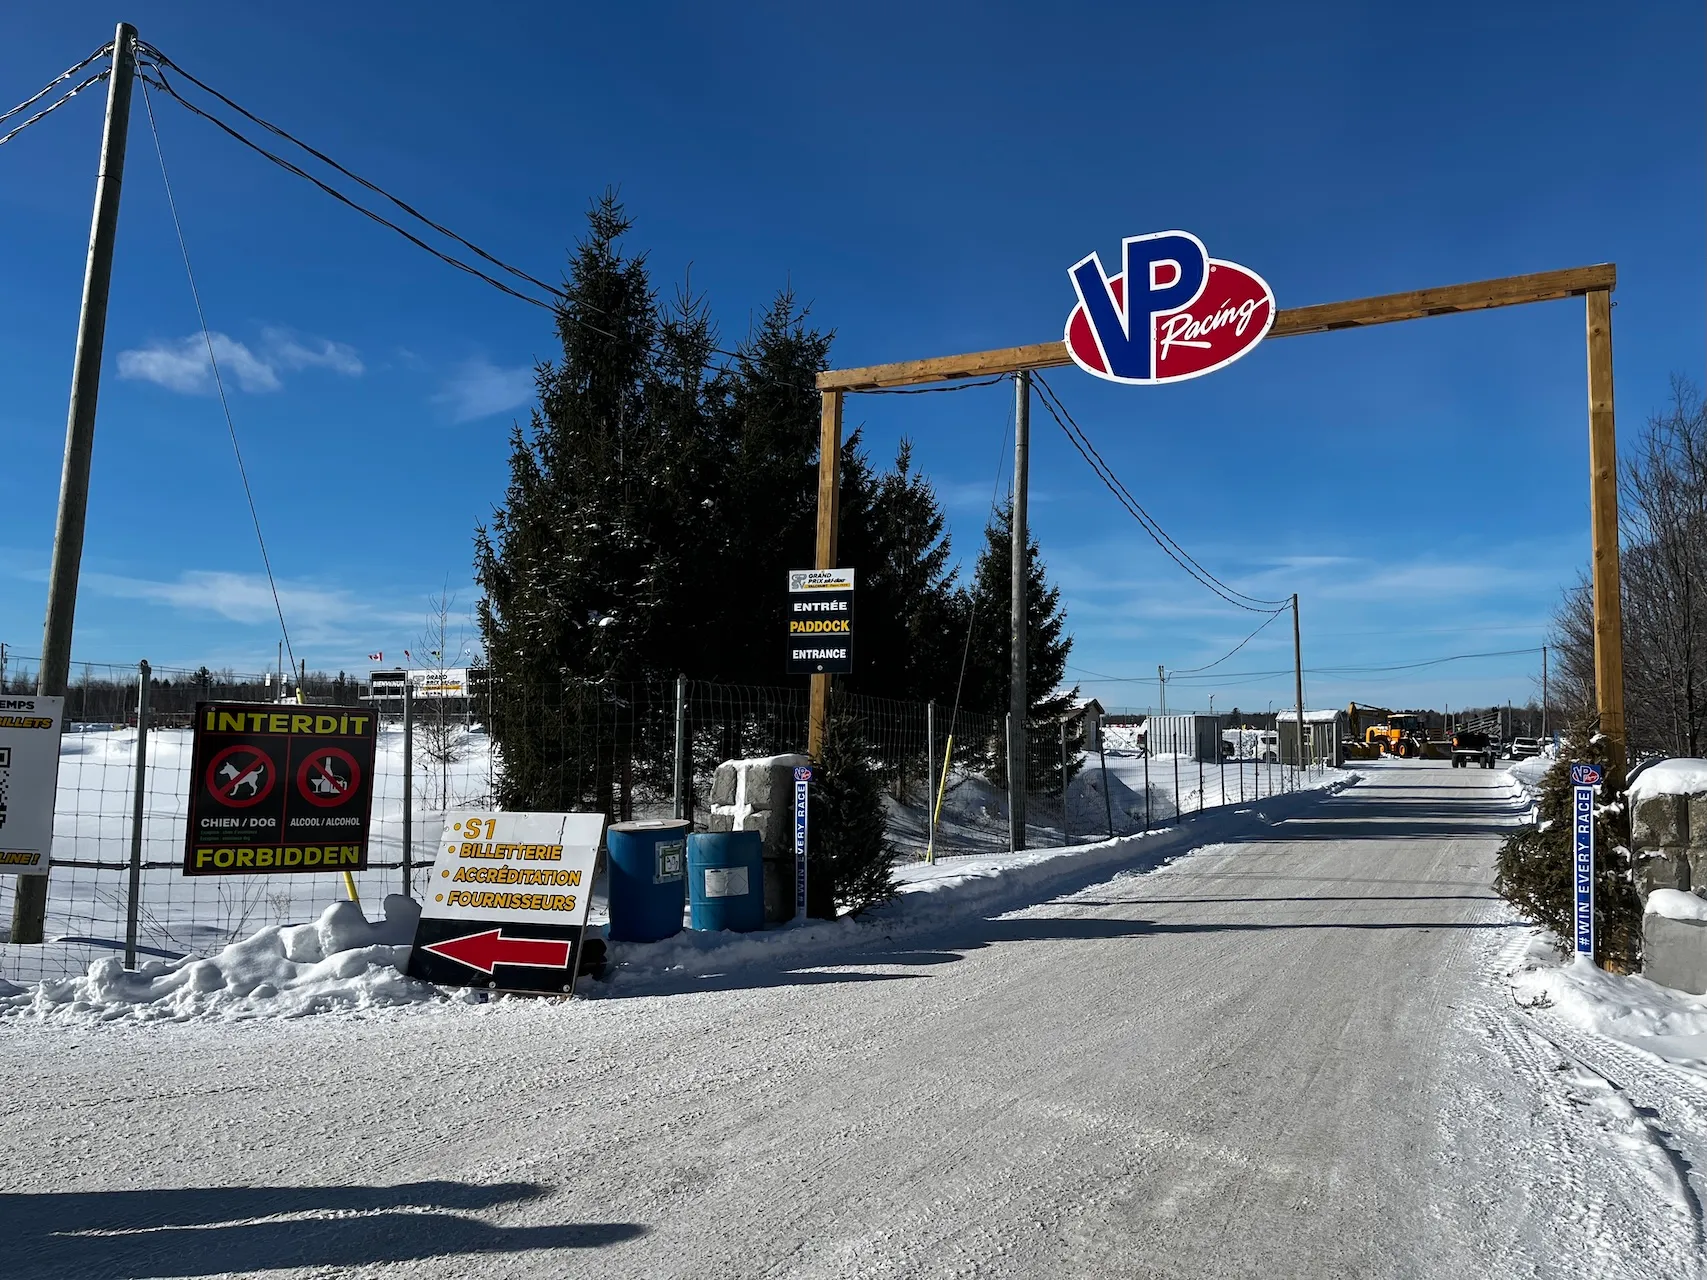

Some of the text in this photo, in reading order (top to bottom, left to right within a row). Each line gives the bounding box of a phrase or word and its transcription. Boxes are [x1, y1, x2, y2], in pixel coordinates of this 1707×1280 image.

[1068, 230, 1209, 384] VP
[1160, 297, 1268, 361] Racing
[793, 600, 848, 612] ENTRÉE
[790, 620, 850, 633] PADDOCK
[792, 648, 847, 660] ENTRANCE
[206, 711, 370, 736] INTERDIT
[797, 785, 806, 817] RACE
[200, 817, 277, 828] CHIEN / DOG
[289, 817, 321, 828] ALCOOL
[325, 816, 361, 827] ALCOHOL
[463, 817, 497, 840] S1
[459, 843, 563, 861] BILLETTERIE
[797, 822, 806, 864] EVERY
[196, 845, 360, 869] FORBIDDEN
[452, 865, 582, 886] ACCRÉDITATION
[1578, 791, 1590, 946] #WIN EVERY RACE
[447, 891, 577, 911] FOURNISSEURS
